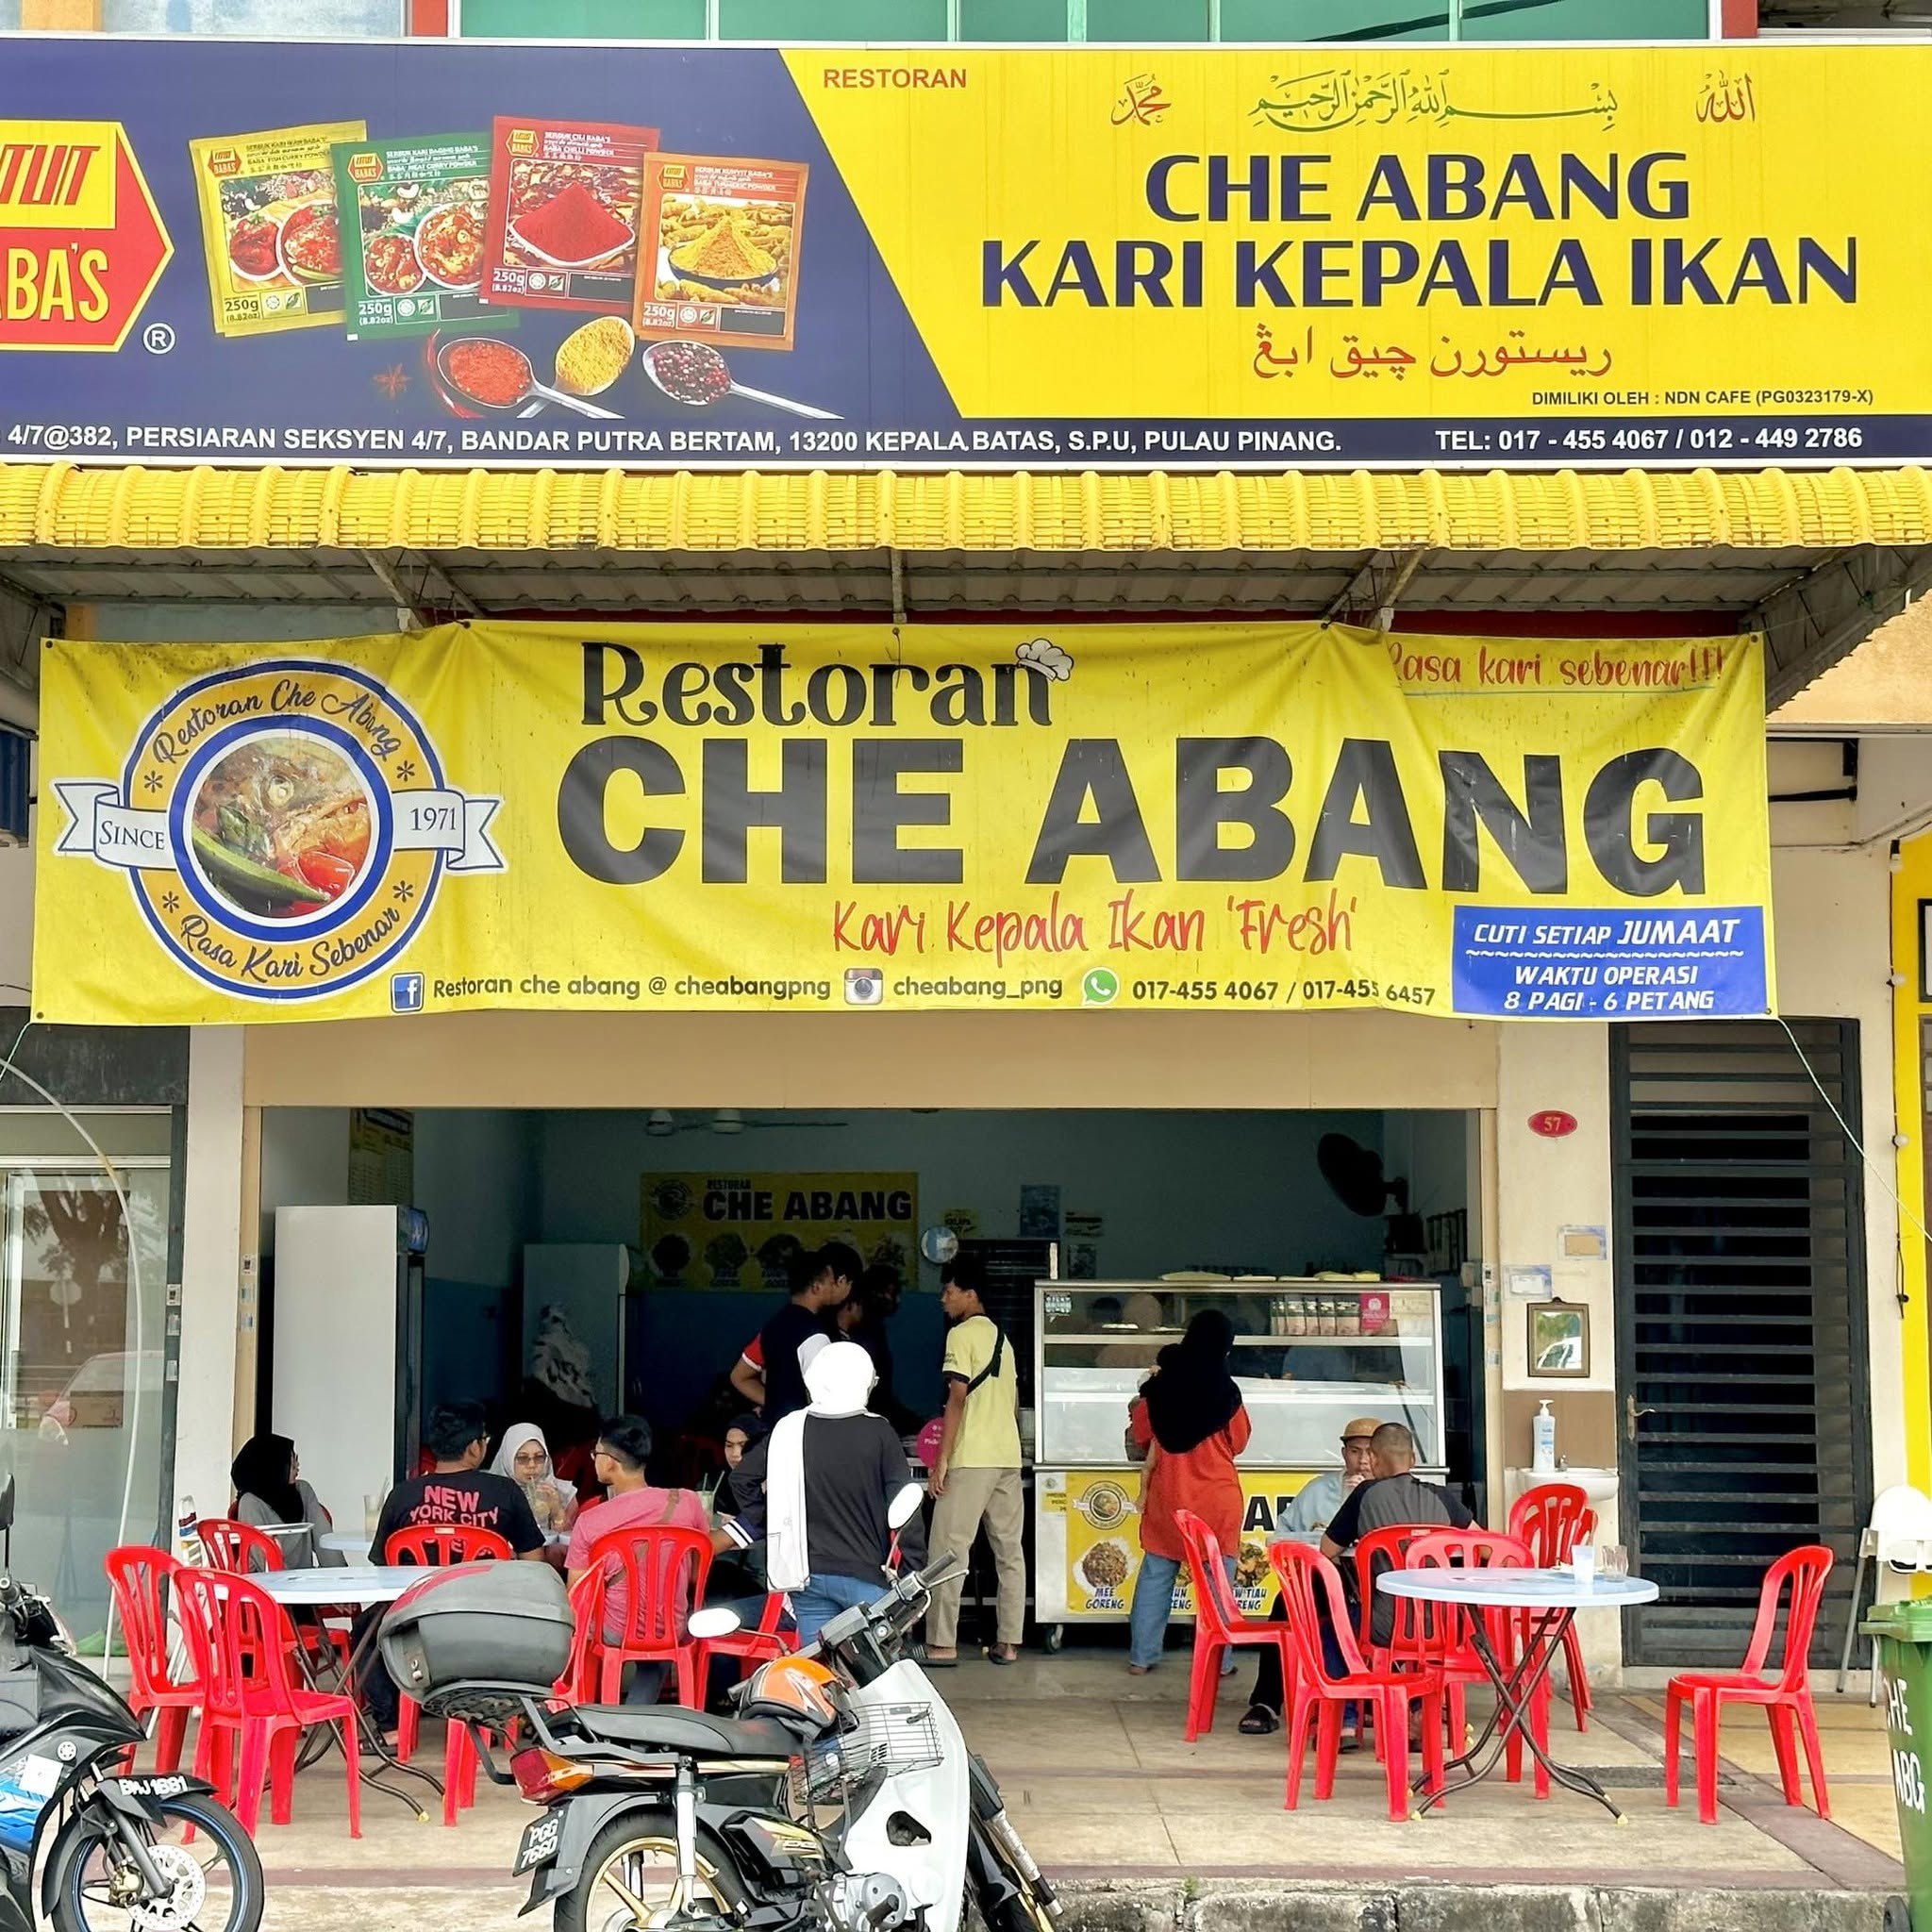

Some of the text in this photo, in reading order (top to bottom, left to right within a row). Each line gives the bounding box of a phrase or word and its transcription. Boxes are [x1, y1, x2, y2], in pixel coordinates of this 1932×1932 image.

[822, 68, 968, 90] RESTORAN
[1145, 152, 1690, 223] CHE ABANG
[0, 242, 109, 322] BA'S
[492, 271, 525, 286] 250g
[981, 237, 1857, 308] KARI KEPALA IKAN
[225, 298, 259, 312] 250g
[358, 302, 393, 317] 250g
[643, 305, 676, 321] 250g
[1532, 391, 1599, 406] DIMILIKI
[1603, 391, 1650, 405] OLEH
[1665, 391, 1701, 404] NDN
[1705, 391, 1752, 404] CAFE
[1756, 389, 1874, 406] (PG0323179-X)
[7, 425, 119, 451] 4/7@382,
[126, 426, 276, 449] PERSIARAN
[284, 427, 405, 450] SEKSYEN
[411, 428, 454, 454] 4/7,
[461, 430, 571, 452] BANDAR
[577, 431, 661, 452] PUTRA
[671, 431, 782, 455] BERTAM,
[790, 431, 858, 452] 13200
[973, 430, 1061, 455] BATAS,
[1068, 431, 1138, 455] S.P.U,
[1145, 431, 1230, 452] PULAU
[1239, 431, 1341, 452] PINANG.
[1436, 430, 1491, 450] TEL:
[1498, 430, 1541, 450] 017
[1562, 430, 1606, 450] 455
[1611, 429, 1668, 450] 4067
[1690, 429, 1734, 450] 012
[1756, 428, 1798, 449] 449
[1805, 427, 1863, 449] 2786
[1479, 645, 1541, 685] kari
[1559, 645, 1724, 687] sebenar!!!
[580, 641, 1054, 727] Restoran
[153, 678, 403, 766] Restoran Che Abang
[408, 808, 458, 832] 1971
[557, 733, 1707, 898] CHE ABANG
[833, 887, 1358, 968] Kari Kepala Ikan 'Fresh'
[1474, 918, 1740, 945] CUTI SETIAP JUMAAT
[180, 906, 401, 984] Rasa Kari Sebenar
[433, 974, 832, 1001] Restoran che abang @ cheabangpng
[892, 974, 1064, 1000] cheabang_png
[1514, 964, 1698, 986] WAKTU OPERASI
[1132, 980, 1219, 1001] 017-455
[1224, 981, 1278, 1002] 4067
[1303, 979, 1381, 1002] 017-455
[1385, 984, 1437, 1008] 6457
[1504, 991, 1521, 1010] 8
[1527, 991, 1585, 1012] PAGI
[1603, 991, 1618, 1012] 6
[1543, 1116, 1562, 1132] 57
[703, 1191, 774, 1222] CHE
[783, 1191, 912, 1222] ABANG
[425, 1485, 480, 1512] NEW
[409, 1504, 499, 1527] YORK CITY
[1085, 1599, 1124, 1609] GORENG
[1094, 1587, 1115, 1597] MEE
